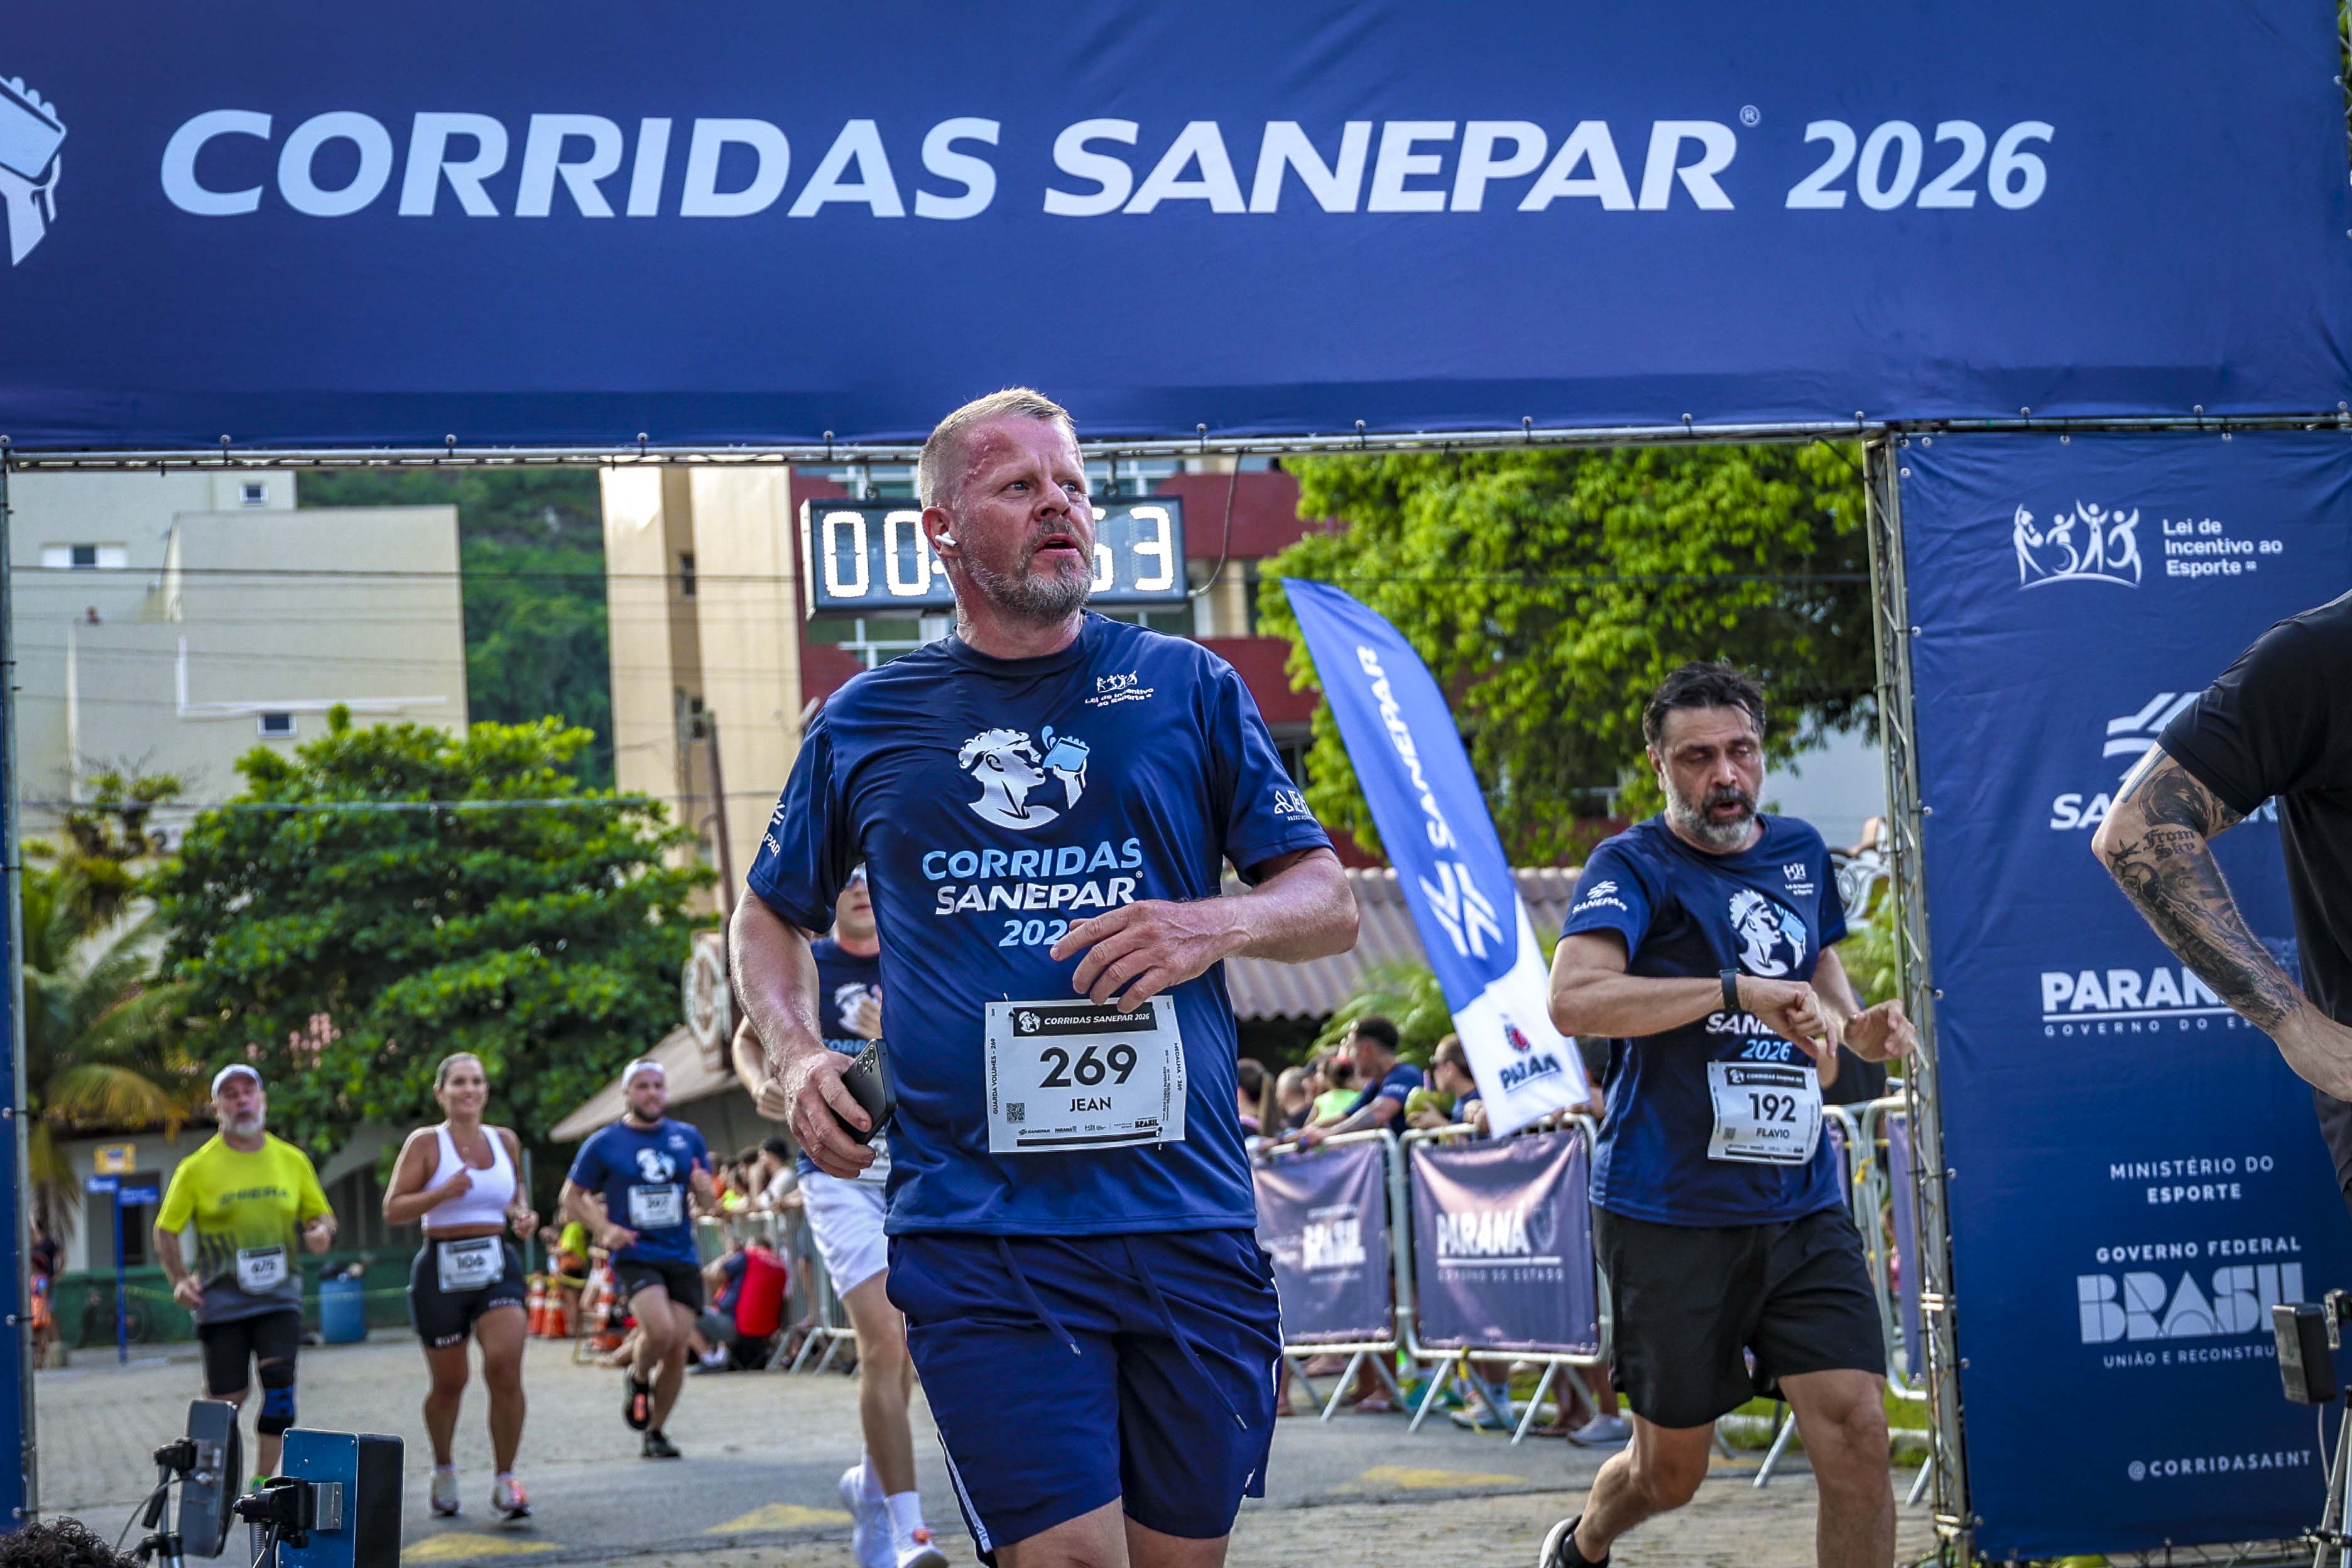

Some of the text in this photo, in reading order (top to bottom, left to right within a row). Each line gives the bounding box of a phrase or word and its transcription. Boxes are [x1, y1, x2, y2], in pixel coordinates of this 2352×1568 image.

[160, 109, 2055, 219] CORRIDAS SANEPAR 2026
[2163, 518, 2222, 535] Lei de
[2165, 538, 2283, 556] Incentivo ao
[2166, 558, 2241, 579] Esporte
[1356, 645, 1457, 851] SANEPAR
[922, 837, 1143, 880] CORRIDAS
[935, 877, 1136, 916] SANEPAR
[999, 919, 1070, 947] 202
[2041, 966, 2224, 1012] PARAN
[1044, 1016, 1091, 1025] CORRIDAS
[1093, 1014, 1133, 1023] SANEPAR
[2044, 1018, 2208, 1037] GOVERNO DO
[1173, 1043, 1182, 1074] MEDALHA
[1740, 1038, 1794, 1061] 2026
[1039, 1043, 1138, 1088] 269
[1069, 1096, 1112, 1112] JEAN
[1748, 1093, 1796, 1123] 192
[1756, 1128, 1790, 1139] FLAVIO
[2110, 1155, 2273, 1180] MINISTÉRIO DO
[2147, 1183, 2241, 1204] ESPORTE
[2096, 1236, 2301, 1264] GOVERNO FEDERAL
[2103, 1345, 2276, 1368] UNIÃO E RECONSTRU
[2128, 1450, 2311, 1481] @CORRIDASAENT
